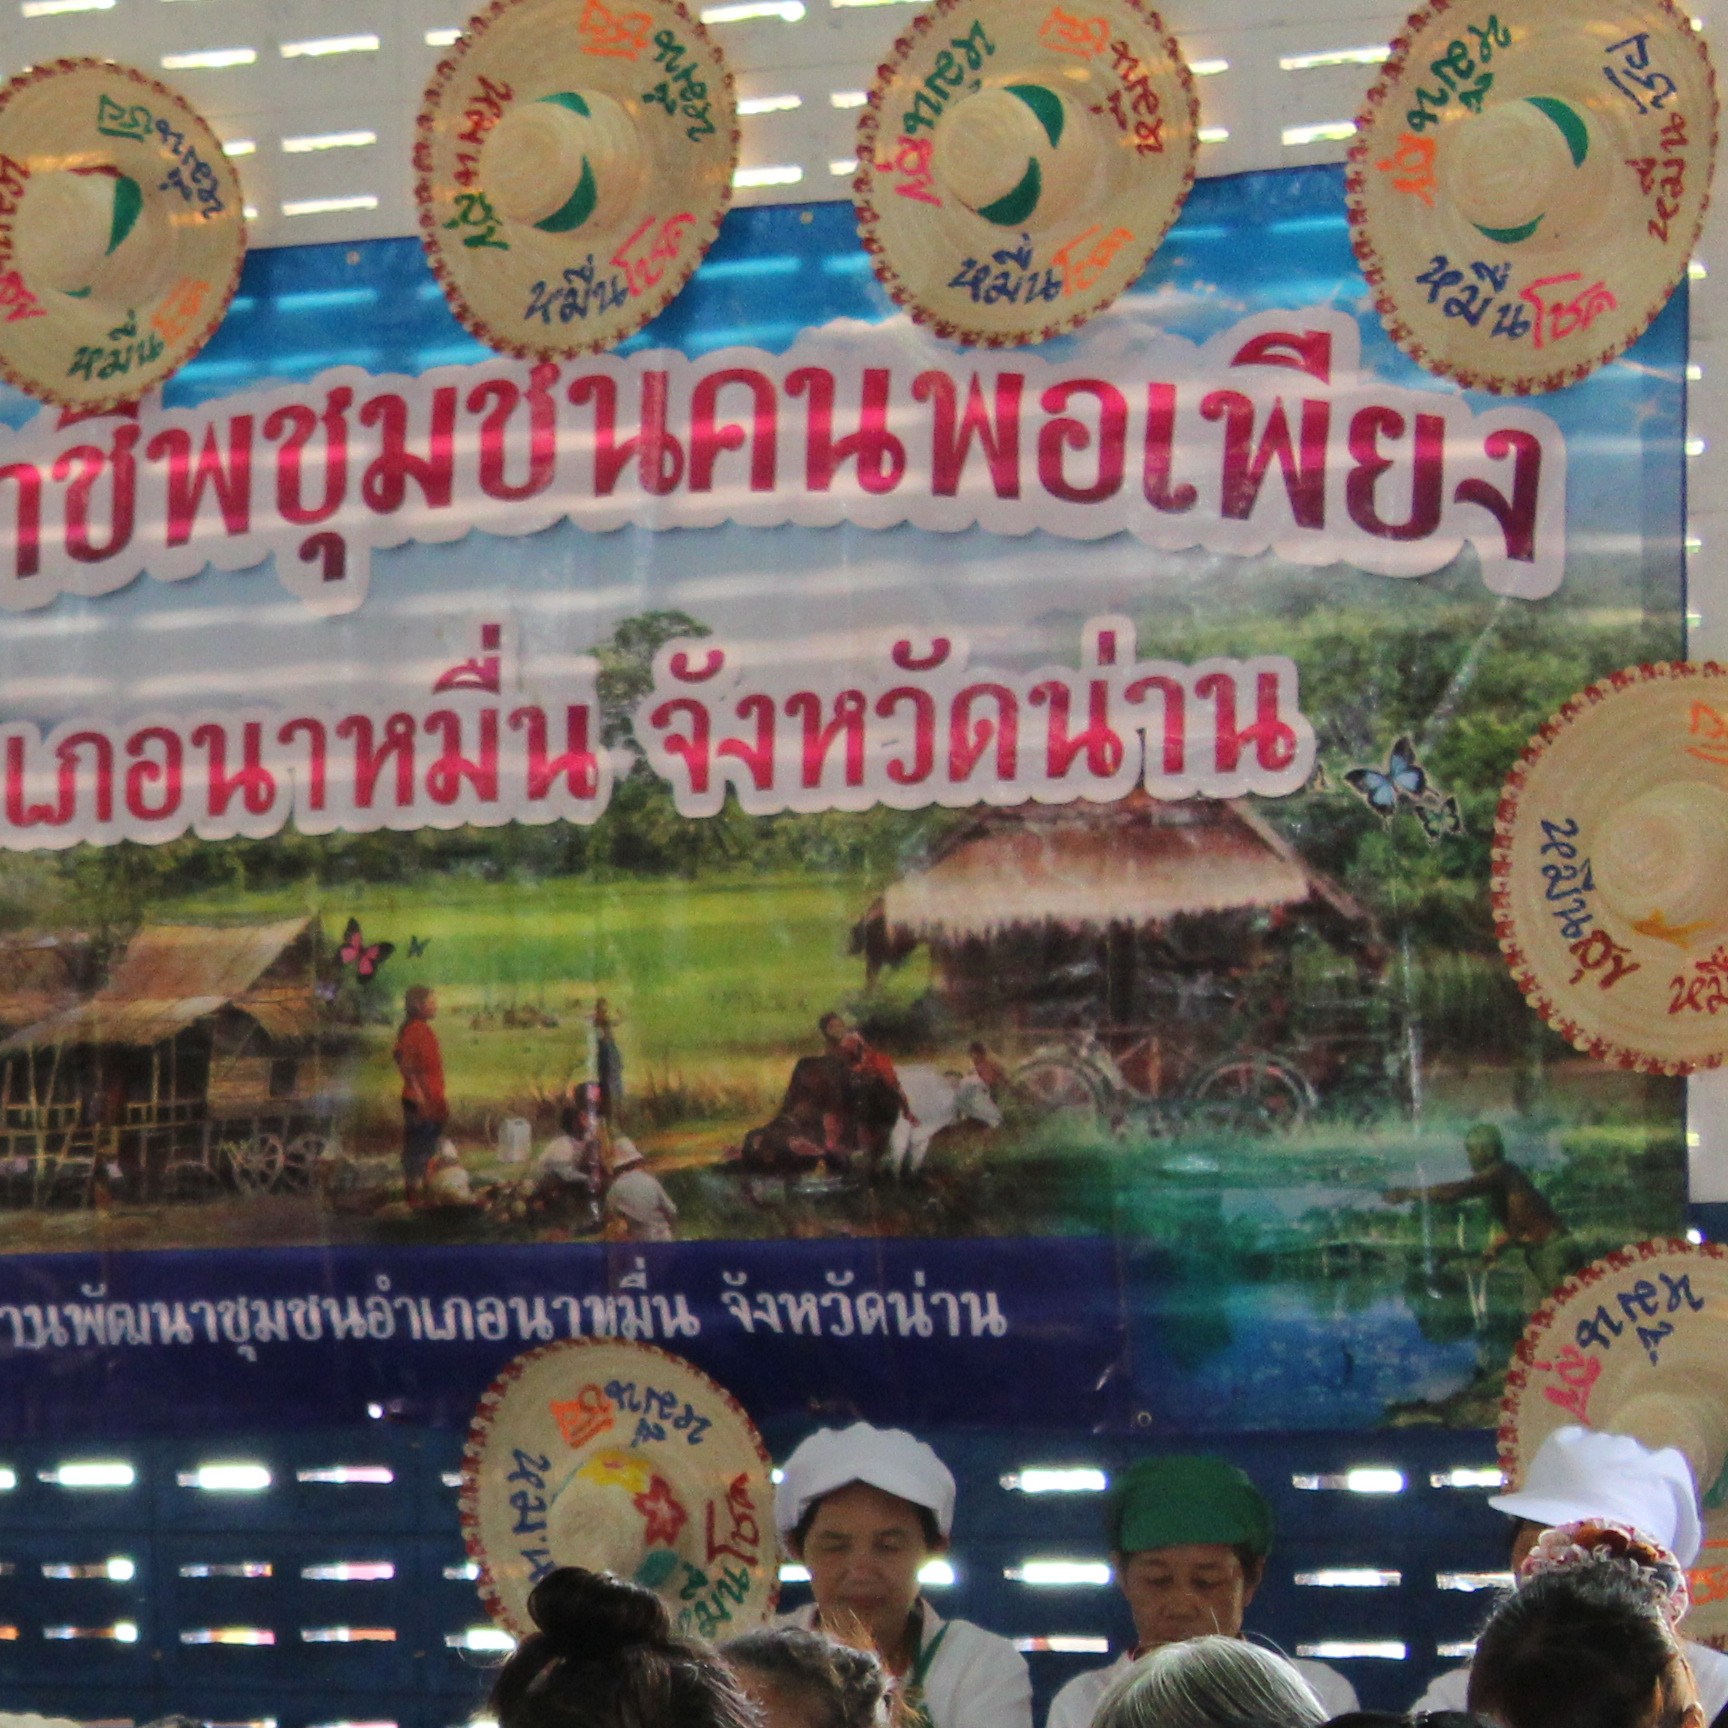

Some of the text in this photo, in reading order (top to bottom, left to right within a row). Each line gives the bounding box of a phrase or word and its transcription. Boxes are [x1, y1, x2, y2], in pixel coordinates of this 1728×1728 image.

[651, 630, 1298, 796] จังหวัดน่าน
[722, 1270, 1008, 1338] จังหวัดน่าน
